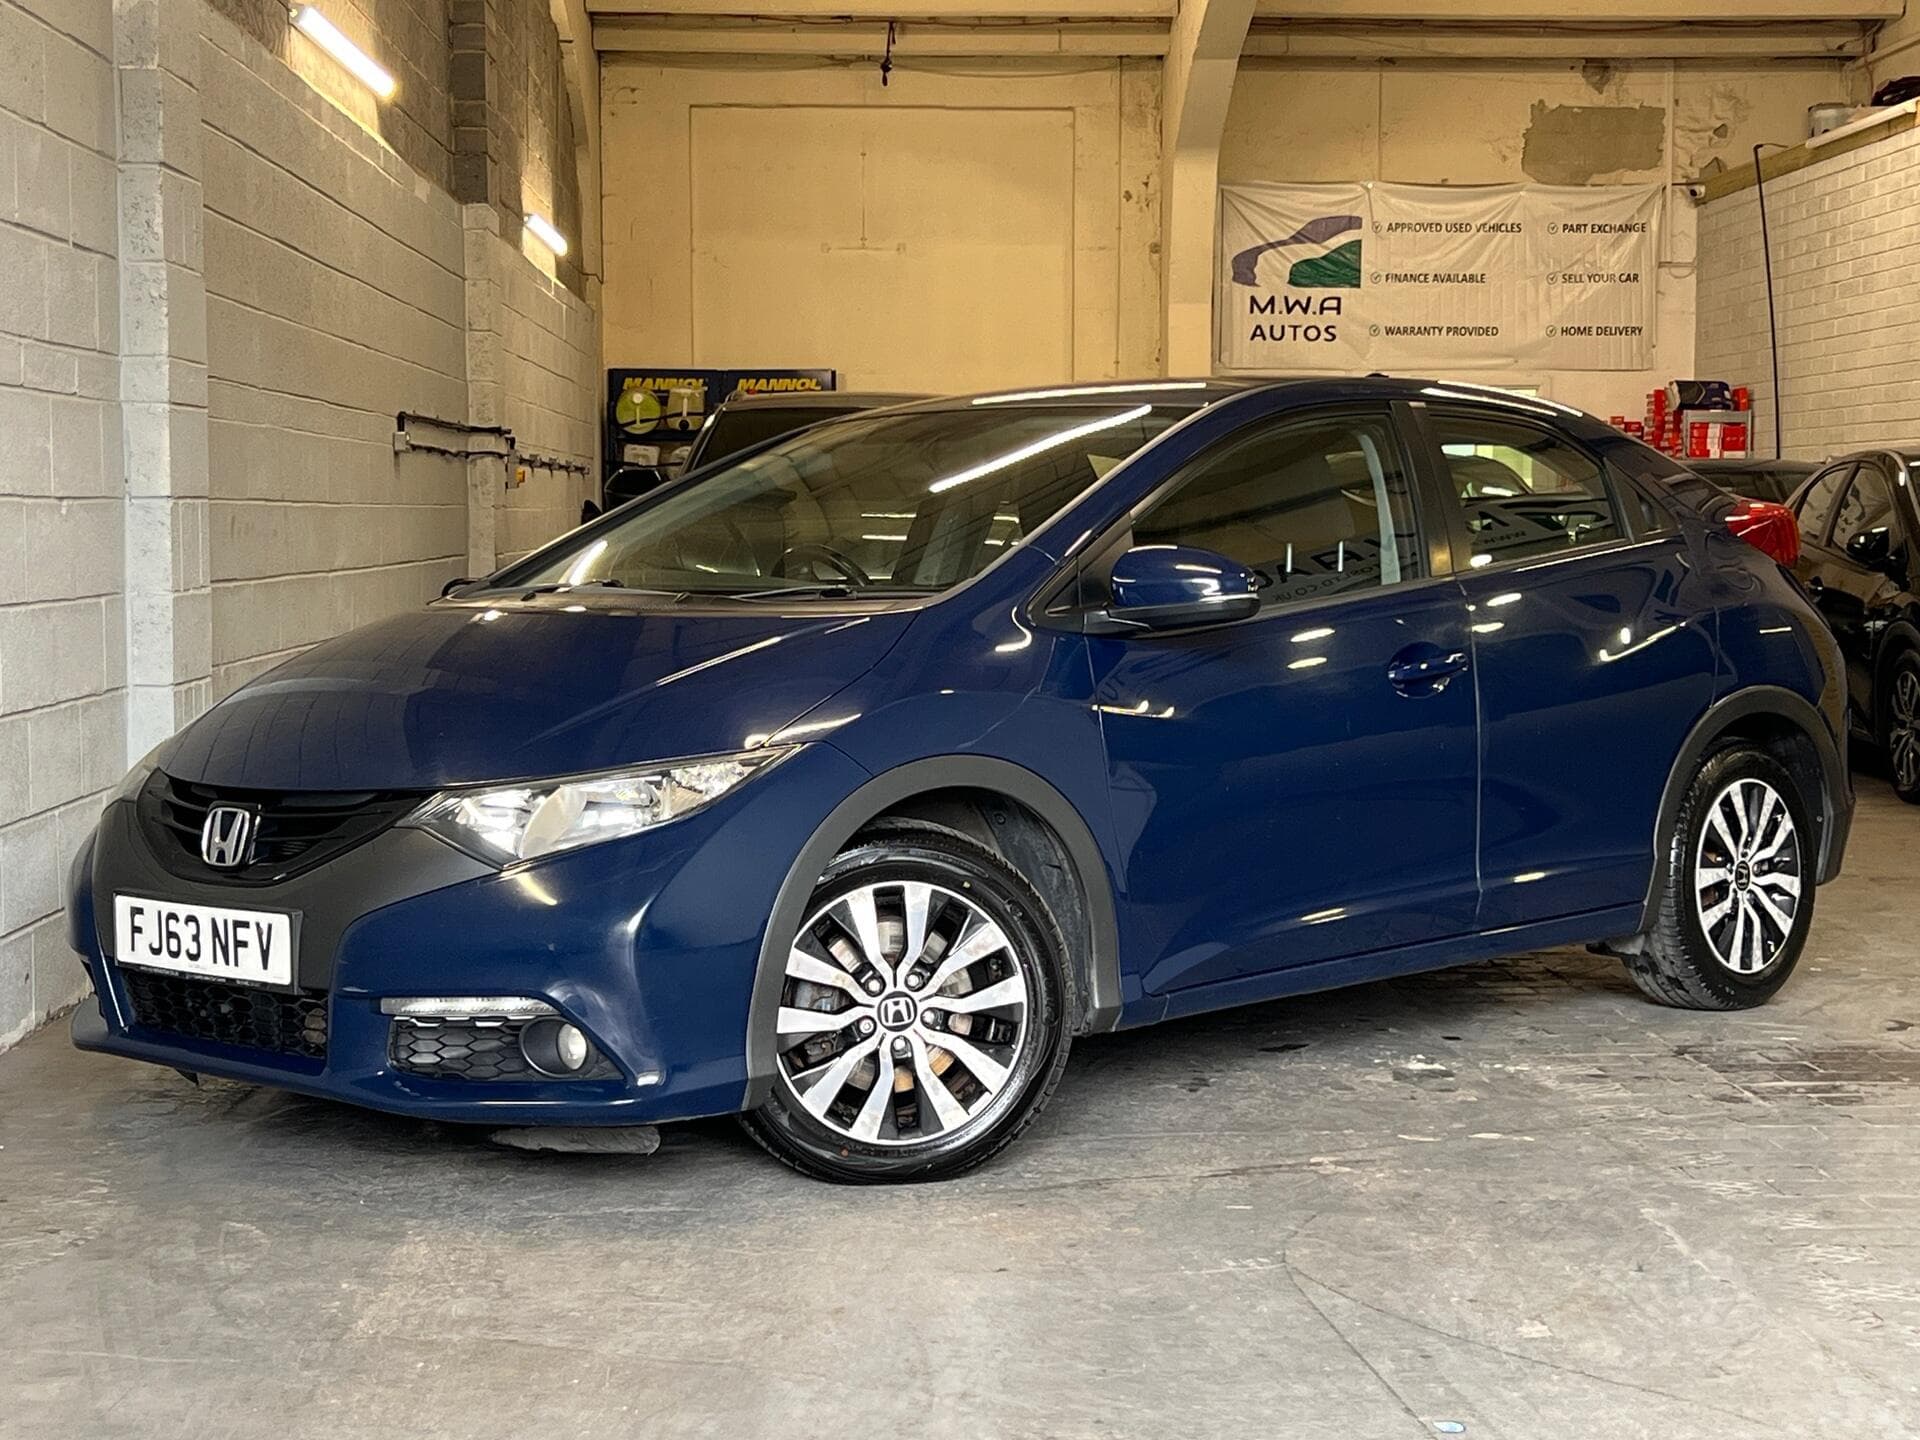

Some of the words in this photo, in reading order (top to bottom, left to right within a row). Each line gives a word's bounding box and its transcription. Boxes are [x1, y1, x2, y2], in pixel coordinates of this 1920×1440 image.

[1386, 222, 1442, 233] APPROVED
[1445, 222, 1473, 233] USED
[1475, 222, 1523, 234] VEHICLES
[1562, 223, 1588, 234] PART
[1590, 222, 1647, 234] EXCHANGE
[1384, 273, 1430, 284] FINANCE
[1432, 273, 1486, 284] AVAILABLE
[1561, 273, 1585, 284] SELL
[1586, 273, 1616, 284] YOUR
[1618, 272, 1640, 283] CAR
[1249, 294, 1342, 316] M.W.A
[1249, 324, 1338, 342] AUTOS
[1384, 325, 1444, 337] WARRANTY
[1446, 325, 1499, 337] PROVIDED
[1560, 326, 1593, 337] HOME
[1595, 326, 1644, 337] DELIVERY
[622, 377, 708, 391] MANNOL
[737, 377, 823, 392] MANNOL
[129, 906, 201, 962] FJ63
[210, 916, 273, 971] NFV
